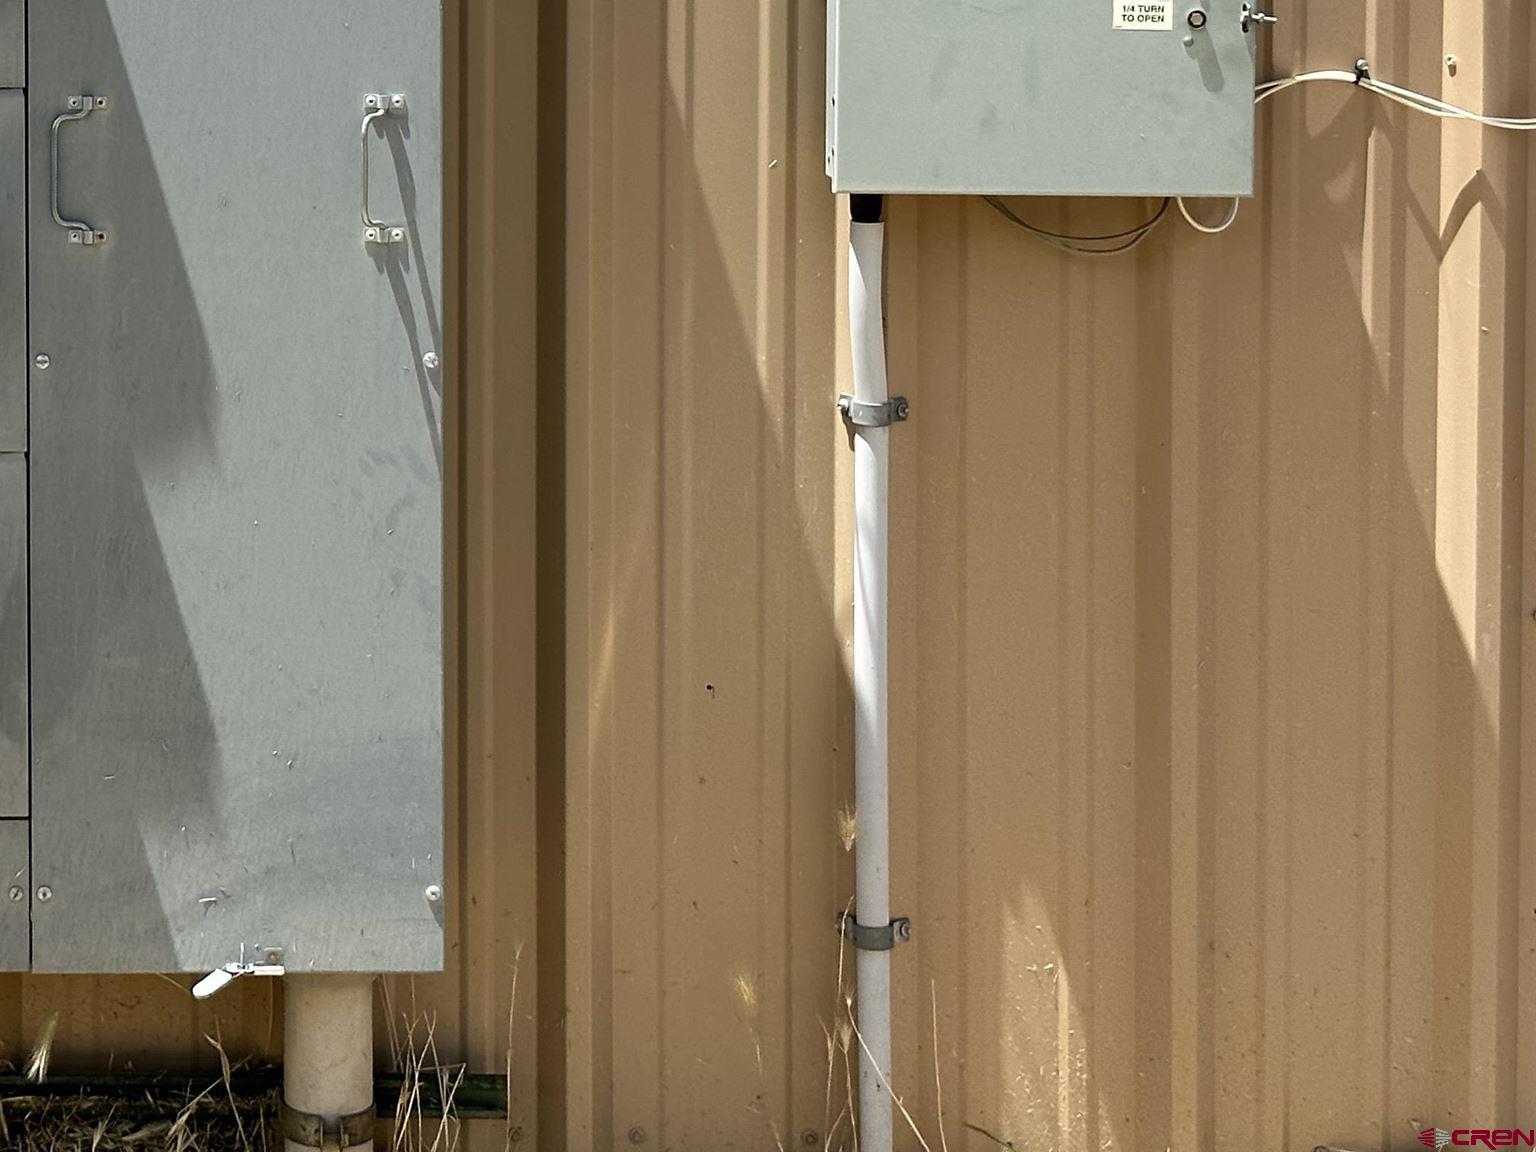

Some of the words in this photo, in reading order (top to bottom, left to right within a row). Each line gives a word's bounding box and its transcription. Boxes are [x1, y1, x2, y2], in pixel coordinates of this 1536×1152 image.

[1122, 5, 1135, 13] 1/4
[1138, 5, 1165, 13] TURN
[1121, 14, 1134, 23] TO
[1137, 14, 1165, 23] OPEN
